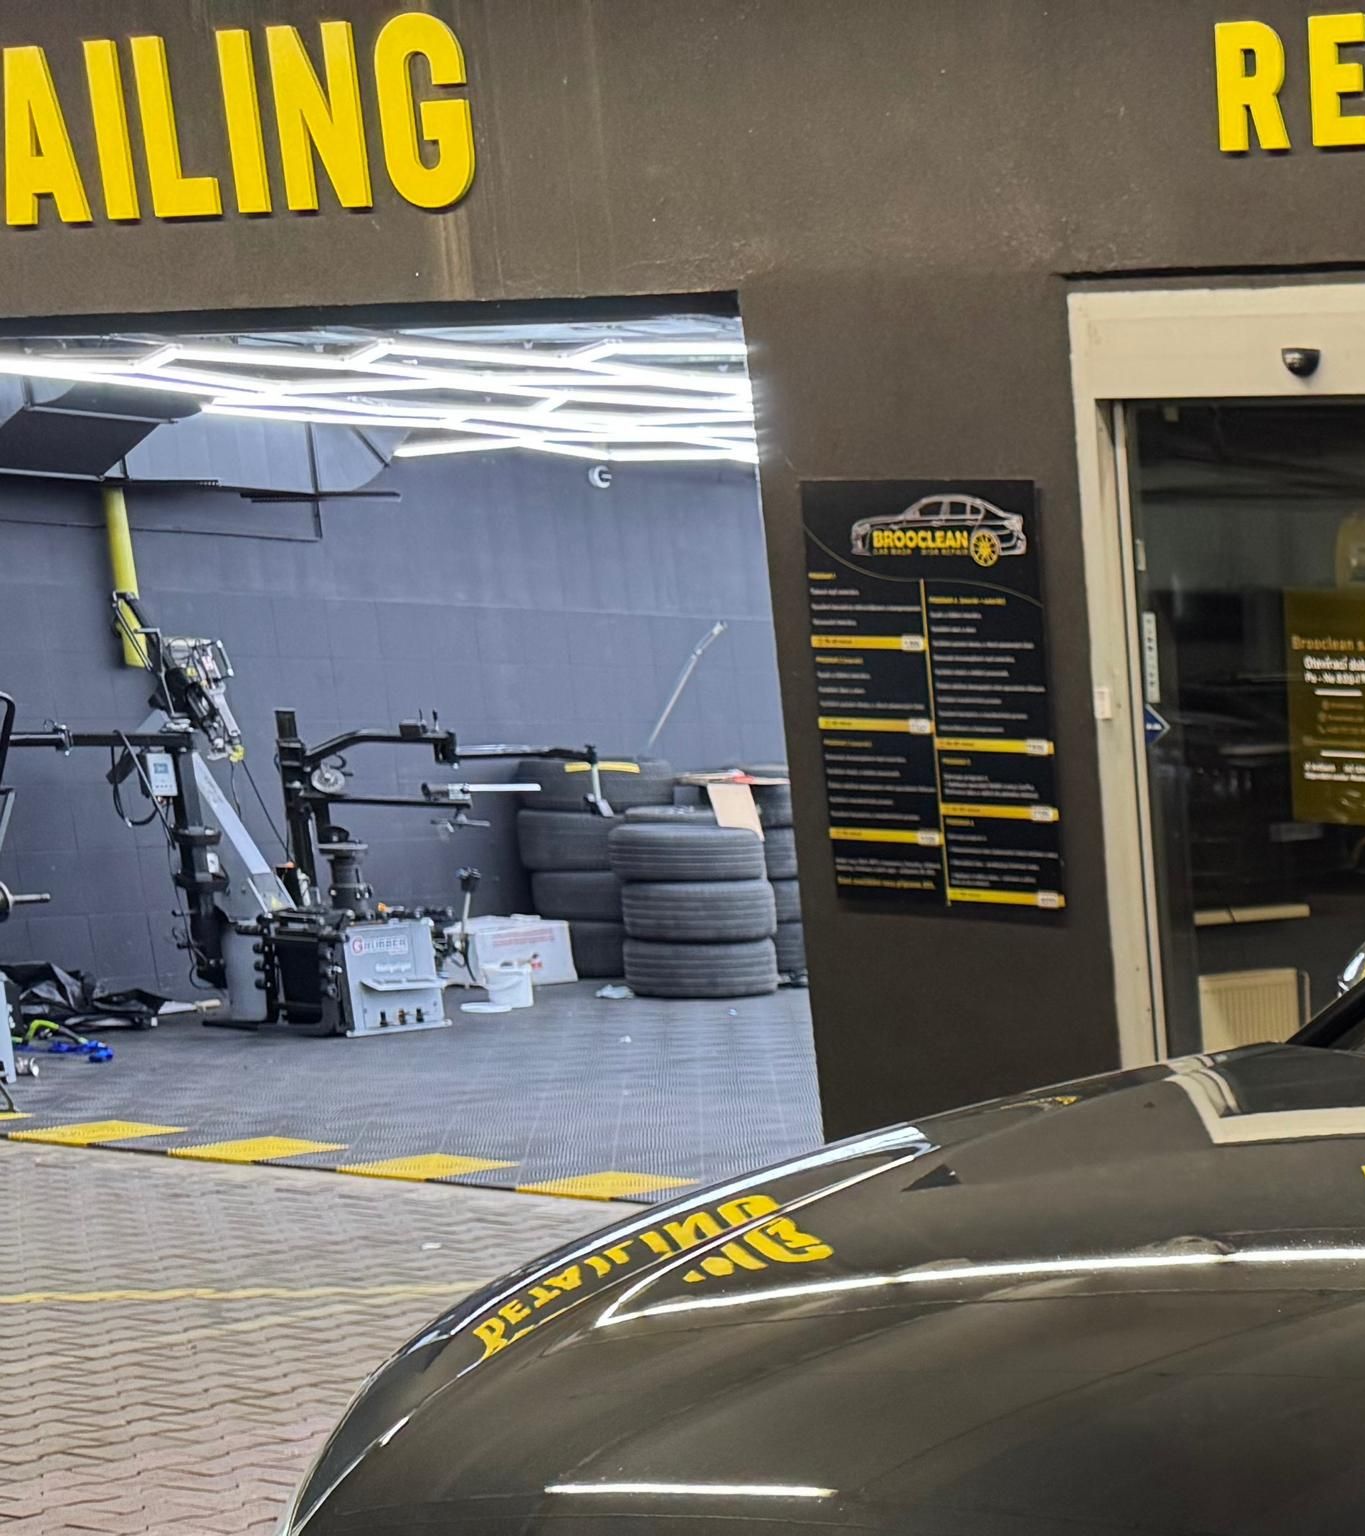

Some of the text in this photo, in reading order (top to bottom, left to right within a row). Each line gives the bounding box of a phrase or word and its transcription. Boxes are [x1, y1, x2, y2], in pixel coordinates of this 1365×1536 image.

[3, 12, 476, 225] AILING
[872, 530, 969, 549] BROOCLEAN
[1291, 633, 1355, 651] Brooclean
